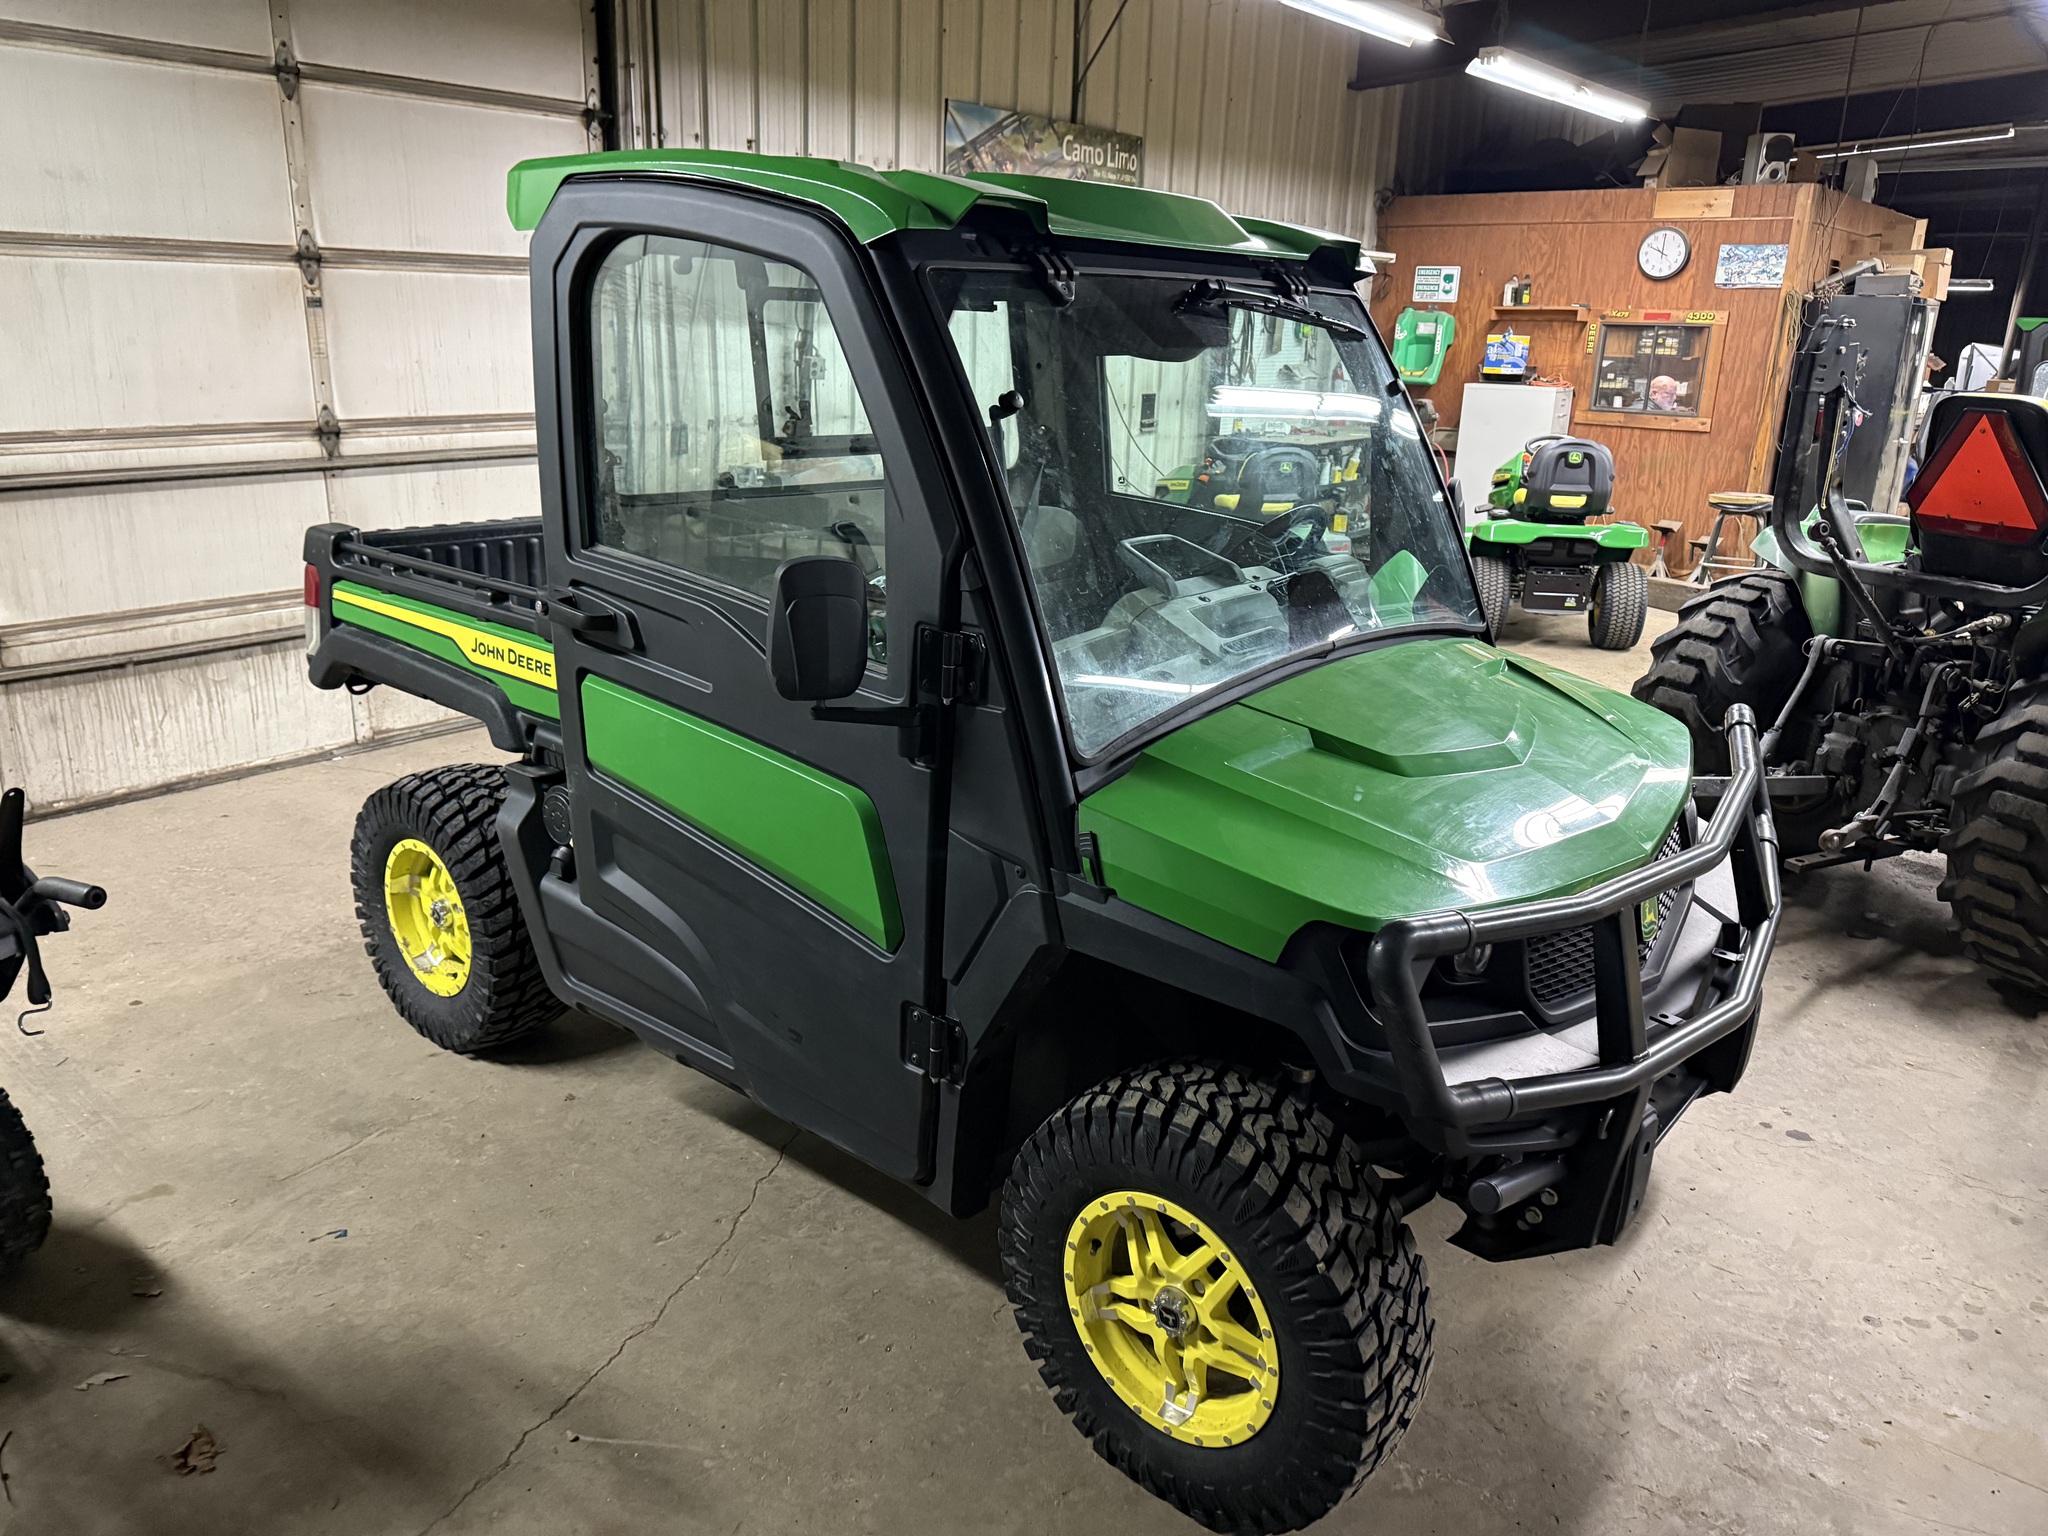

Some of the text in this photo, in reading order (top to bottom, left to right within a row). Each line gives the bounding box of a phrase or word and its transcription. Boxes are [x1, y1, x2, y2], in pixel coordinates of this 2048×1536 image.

[1062, 134, 1137, 171] Camo Limo
[1686, 311, 1715, 321] 4300
[1586, 323, 1597, 355] DEERE
[471, 637, 552, 677] JOHN DEERE
